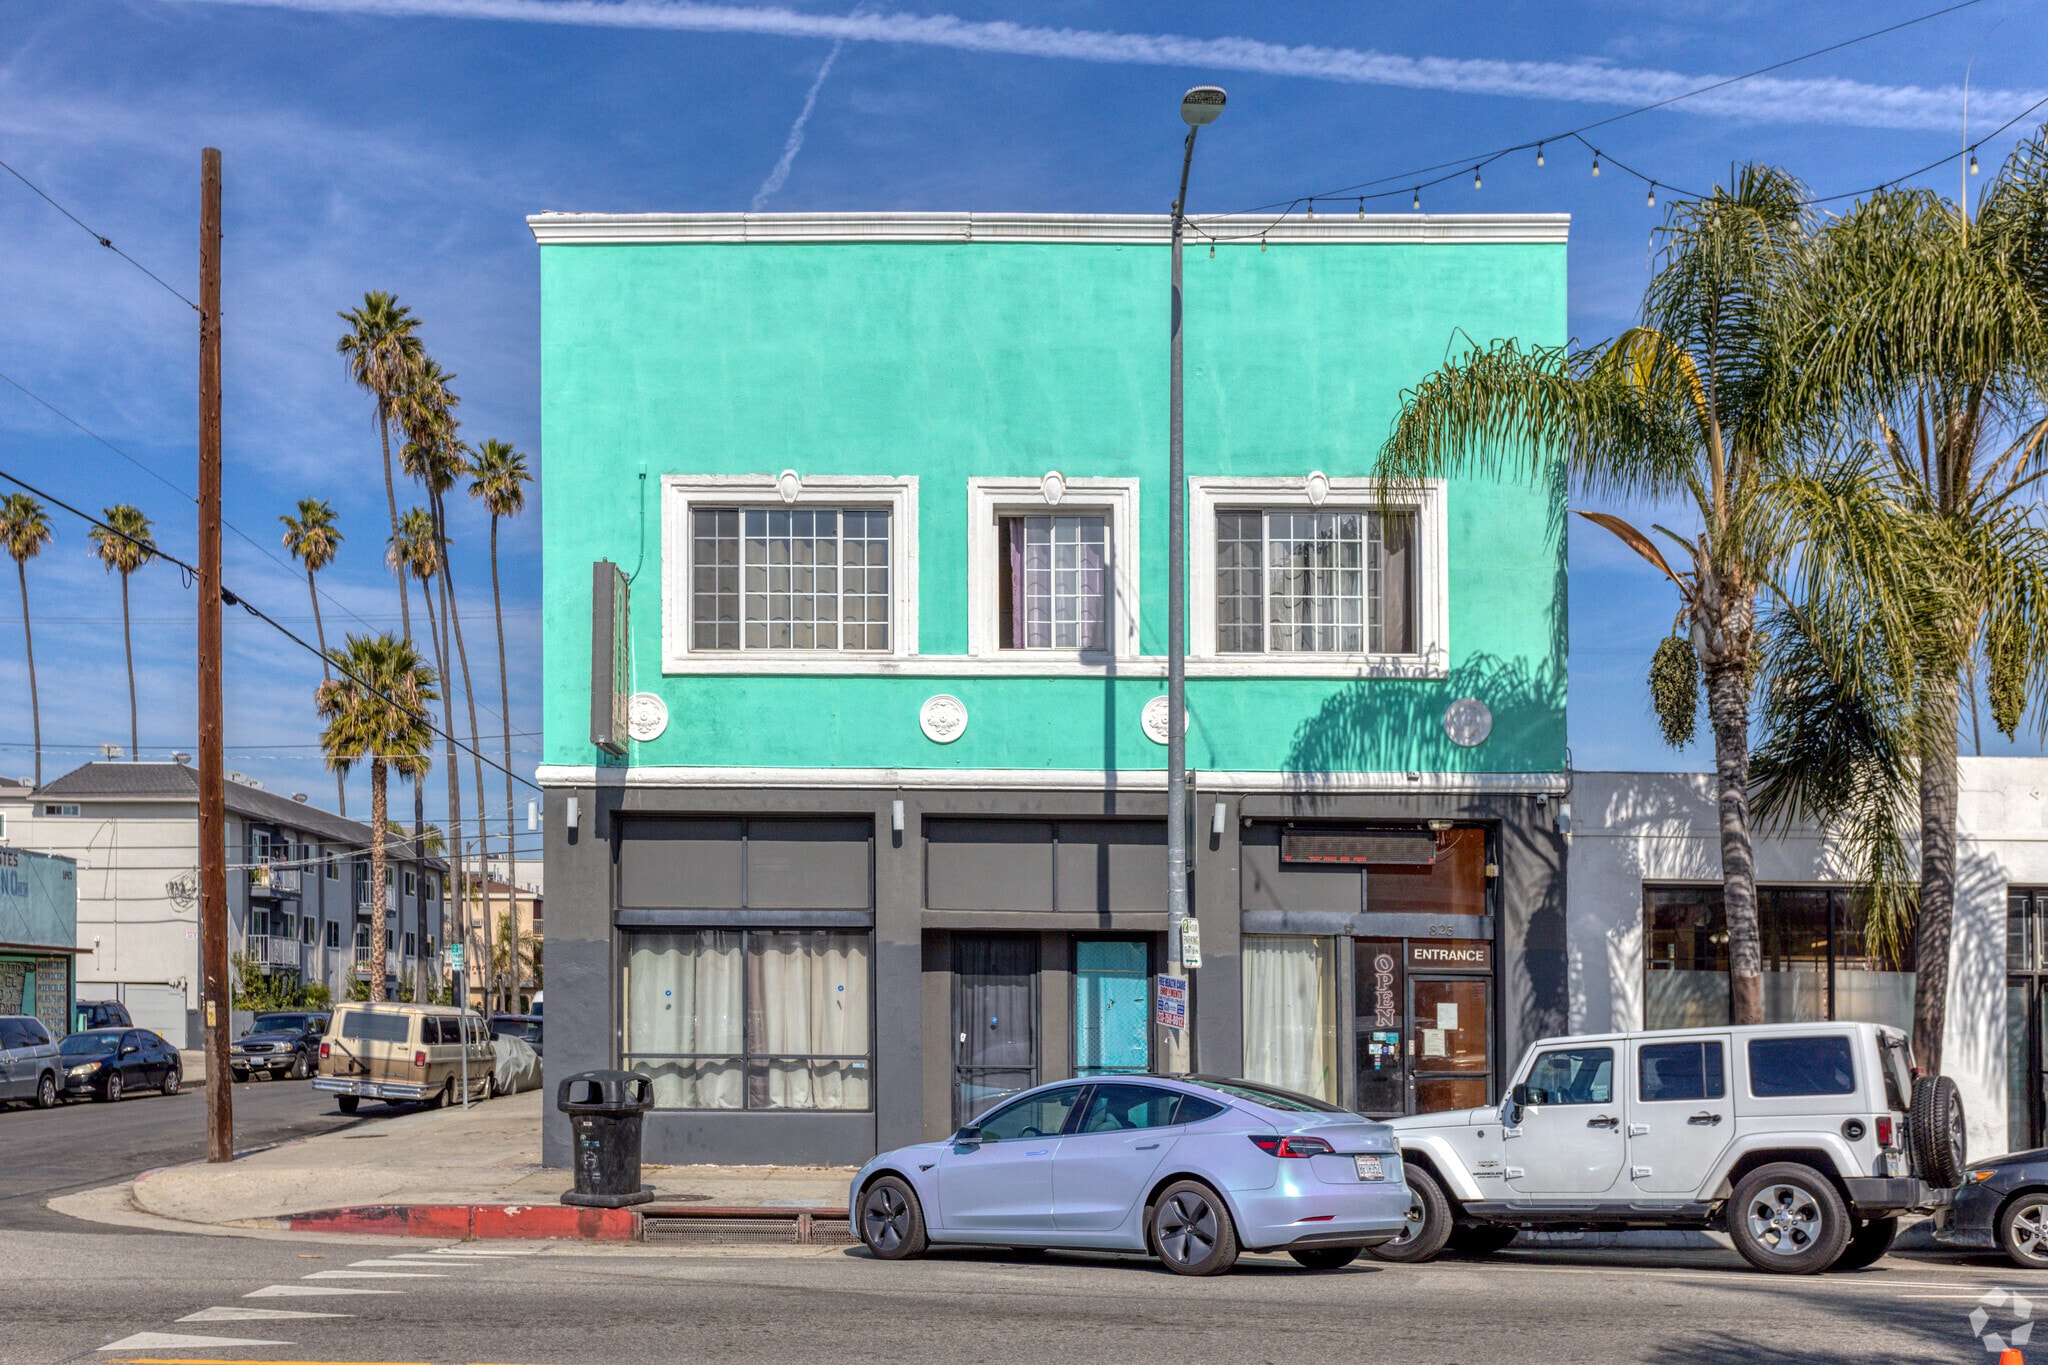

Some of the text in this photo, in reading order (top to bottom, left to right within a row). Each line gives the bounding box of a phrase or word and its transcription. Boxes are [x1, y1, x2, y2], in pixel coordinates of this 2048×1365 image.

[1183, 920, 1188, 932] 2
[1429, 924, 1454, 936] 825
[1414, 948, 1484, 961] ENTRANCE
[1374, 953, 1395, 1027] OPEN
[38, 1006, 65, 1016] VIERNES
